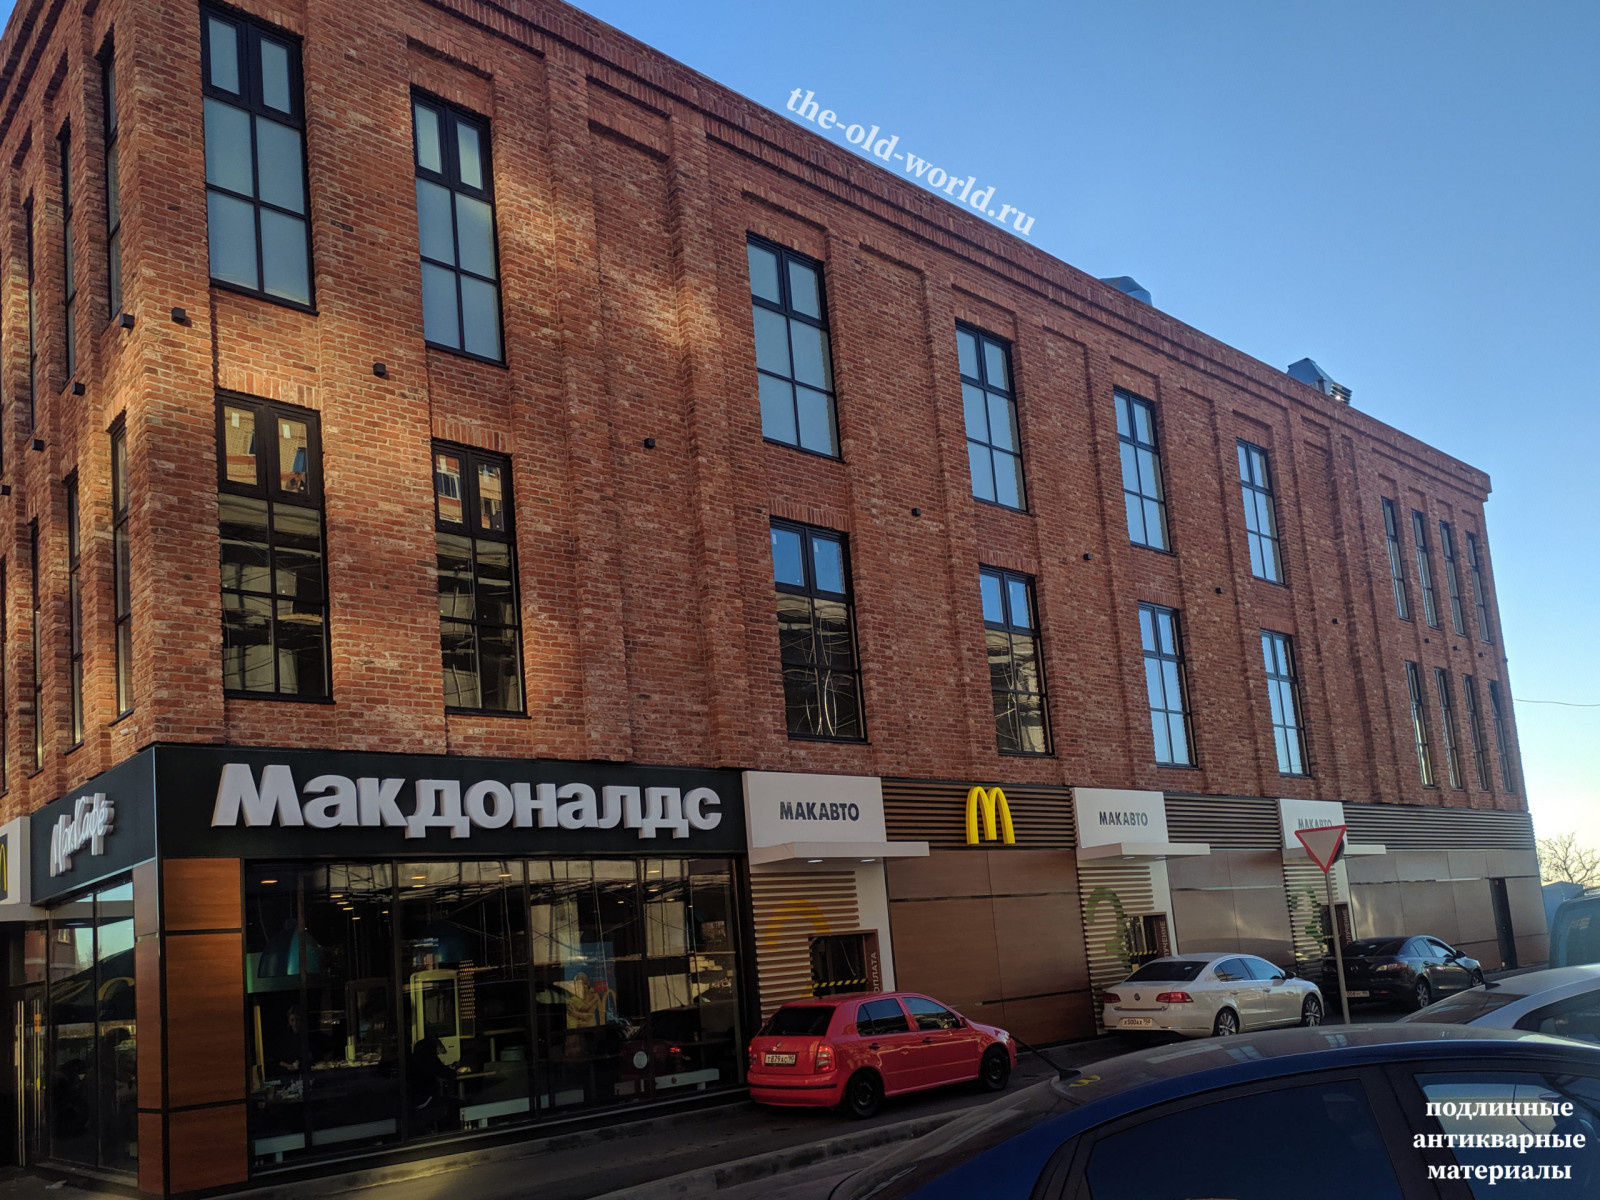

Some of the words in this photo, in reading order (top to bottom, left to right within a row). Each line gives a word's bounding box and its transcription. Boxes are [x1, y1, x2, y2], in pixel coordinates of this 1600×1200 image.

[211, 763, 722, 839] Макдоналдс
[779, 801, 860, 822] МАКАВТО
[1099, 810, 1148, 826] МАКАВТО
